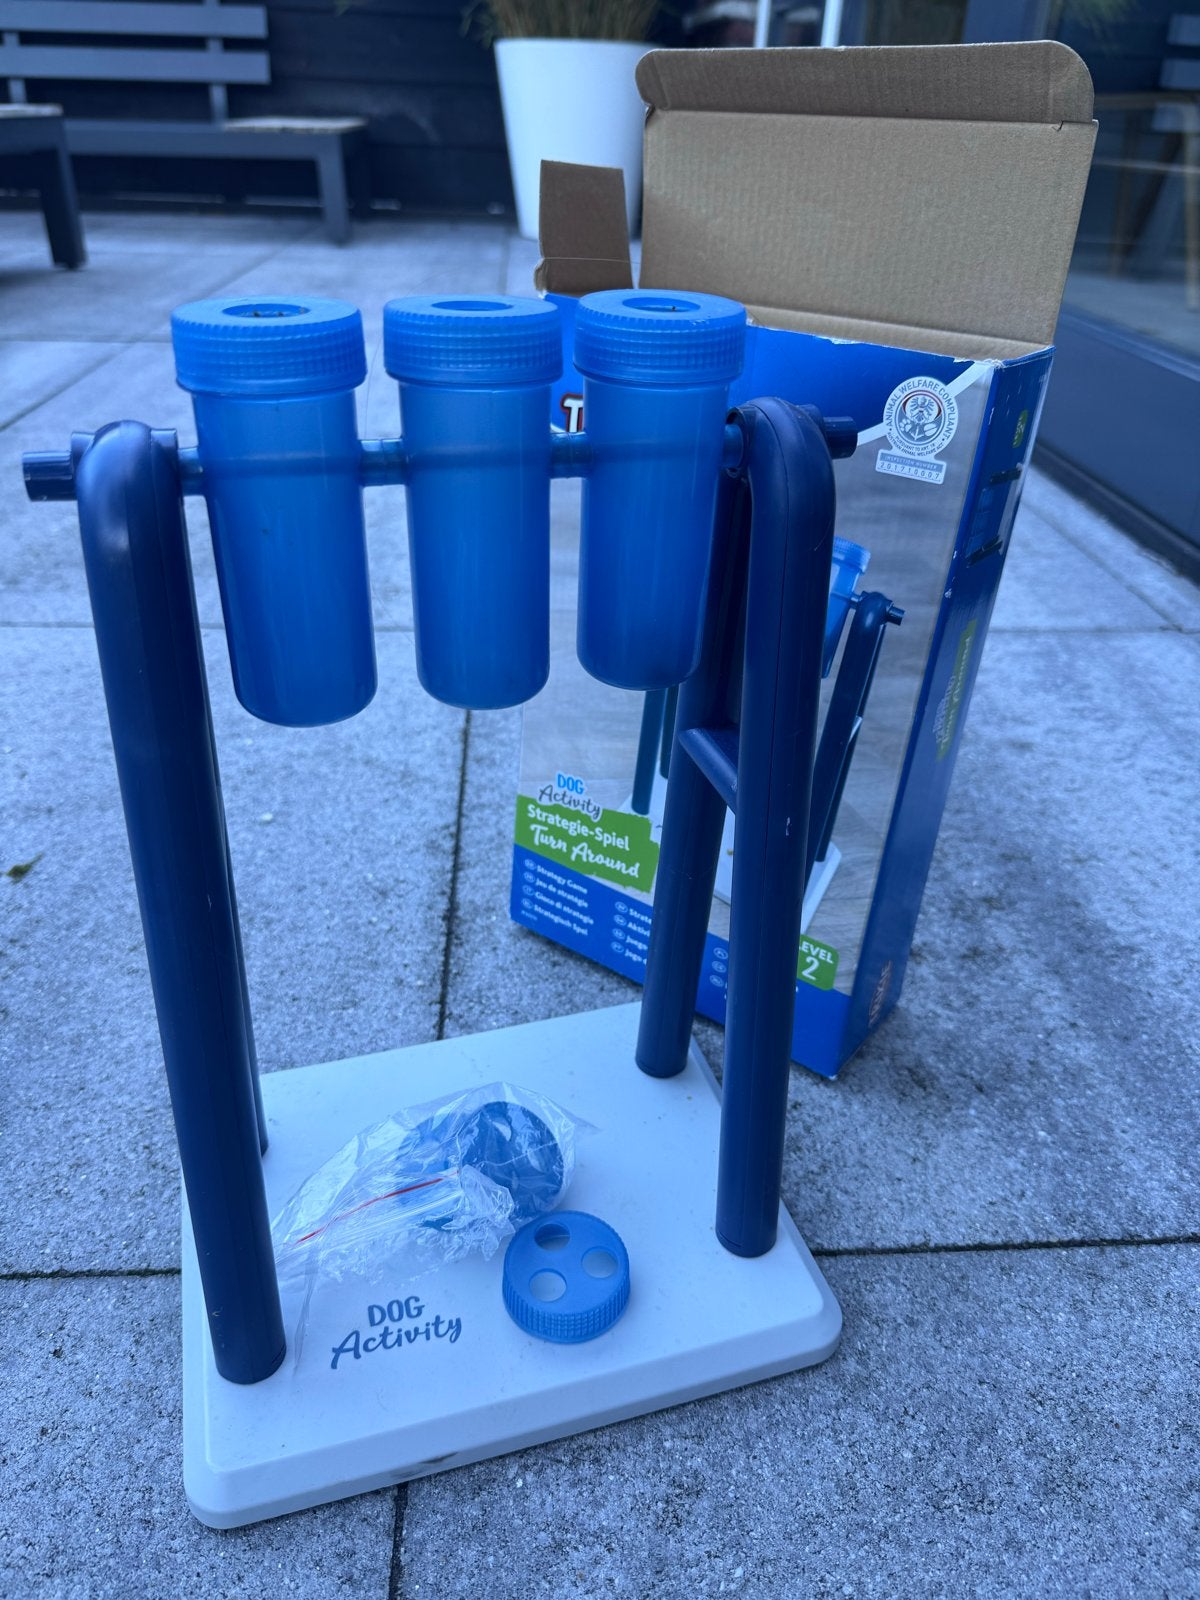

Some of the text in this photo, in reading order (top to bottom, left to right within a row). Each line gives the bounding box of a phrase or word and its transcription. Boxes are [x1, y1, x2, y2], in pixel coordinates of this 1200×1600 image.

[886, 379, 955, 440] ANIMAL WELFARE COMPLIANT
[557, 773, 585, 795] DOG
[539, 784, 601, 820] Activity
[527, 803, 630, 851] Strategie-Spiel
[530, 823, 641, 878] Turn Around
[537, 865, 566, 885] Strategy
[566, 879, 588, 895] Game
[627, 921, 650, 937] Aktivi
[629, 908, 652, 925] Strate
[799, 940, 834, 965] EVEL
[802, 956, 819, 980] 2
[367, 1295, 425, 1327] DOG
[330, 1314, 462, 1370] Activity
